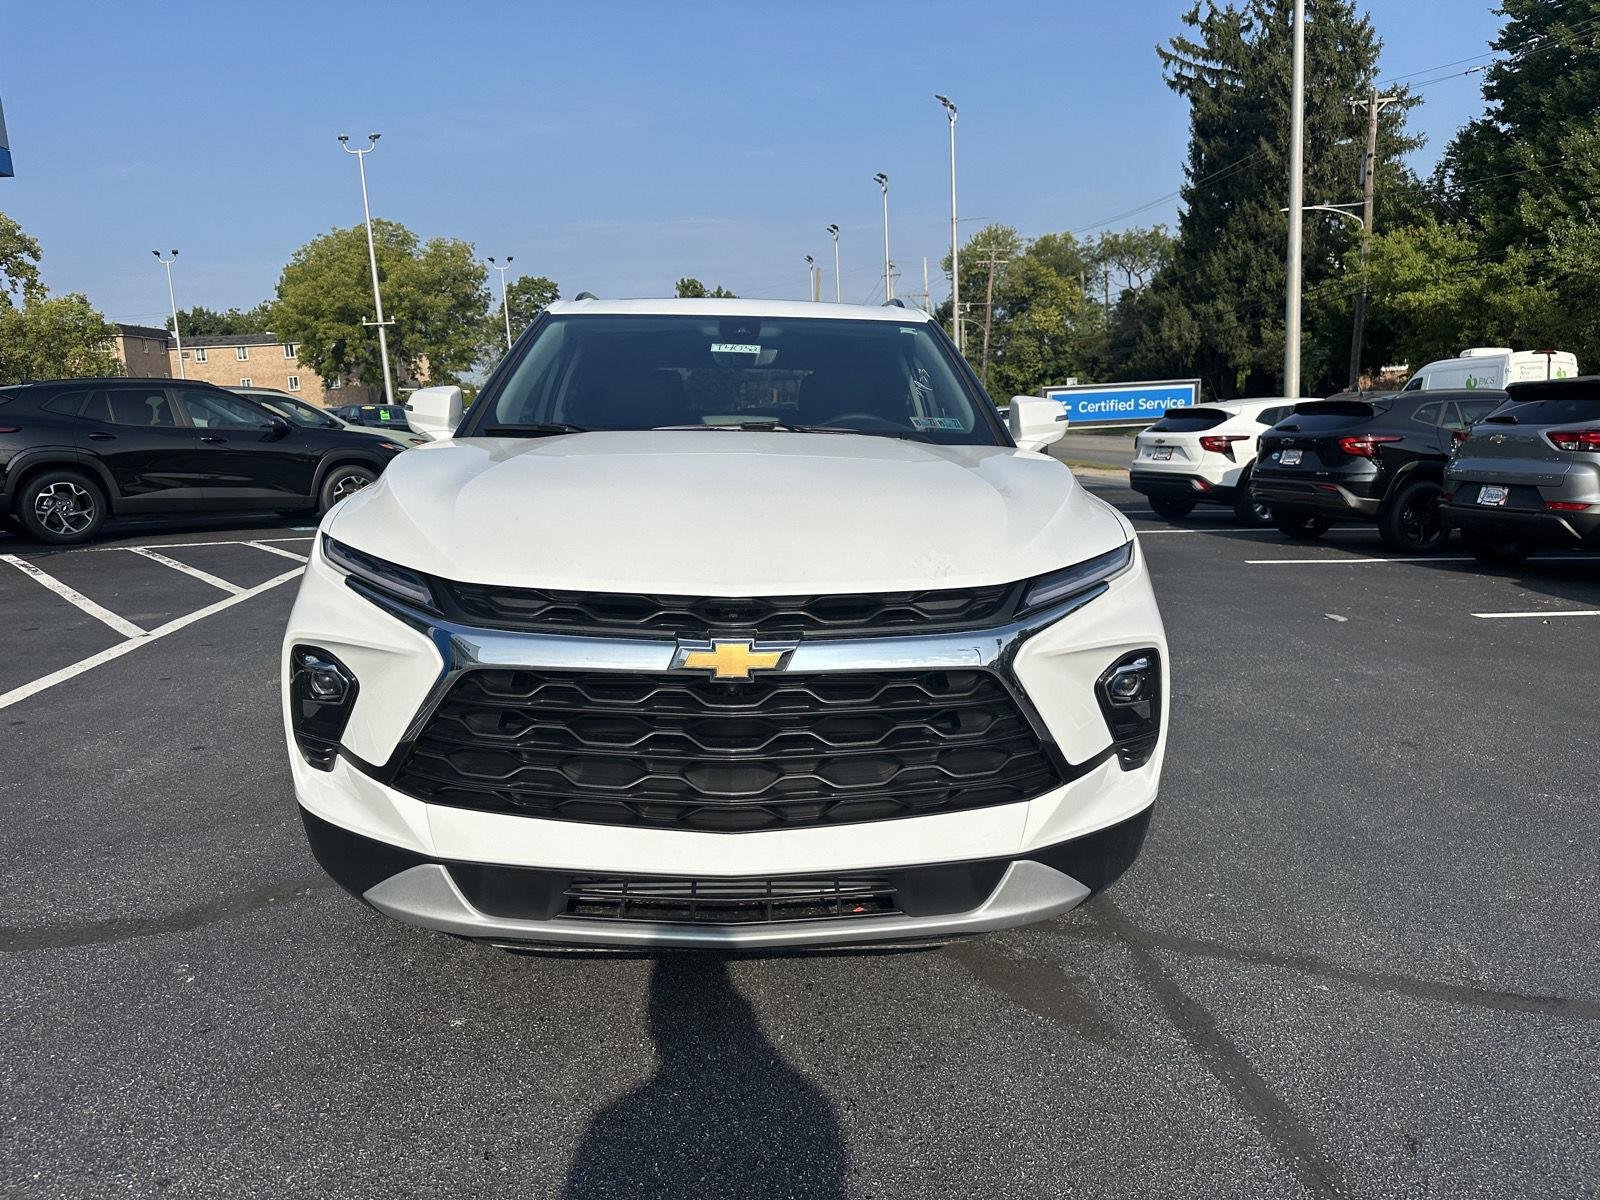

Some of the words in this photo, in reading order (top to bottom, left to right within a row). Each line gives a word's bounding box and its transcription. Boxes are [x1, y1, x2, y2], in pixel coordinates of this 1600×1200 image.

[1478, 376, 1495, 385] PACS
[1078, 400, 1134, 413] Certified
[1138, 397, 1185, 410] Service
